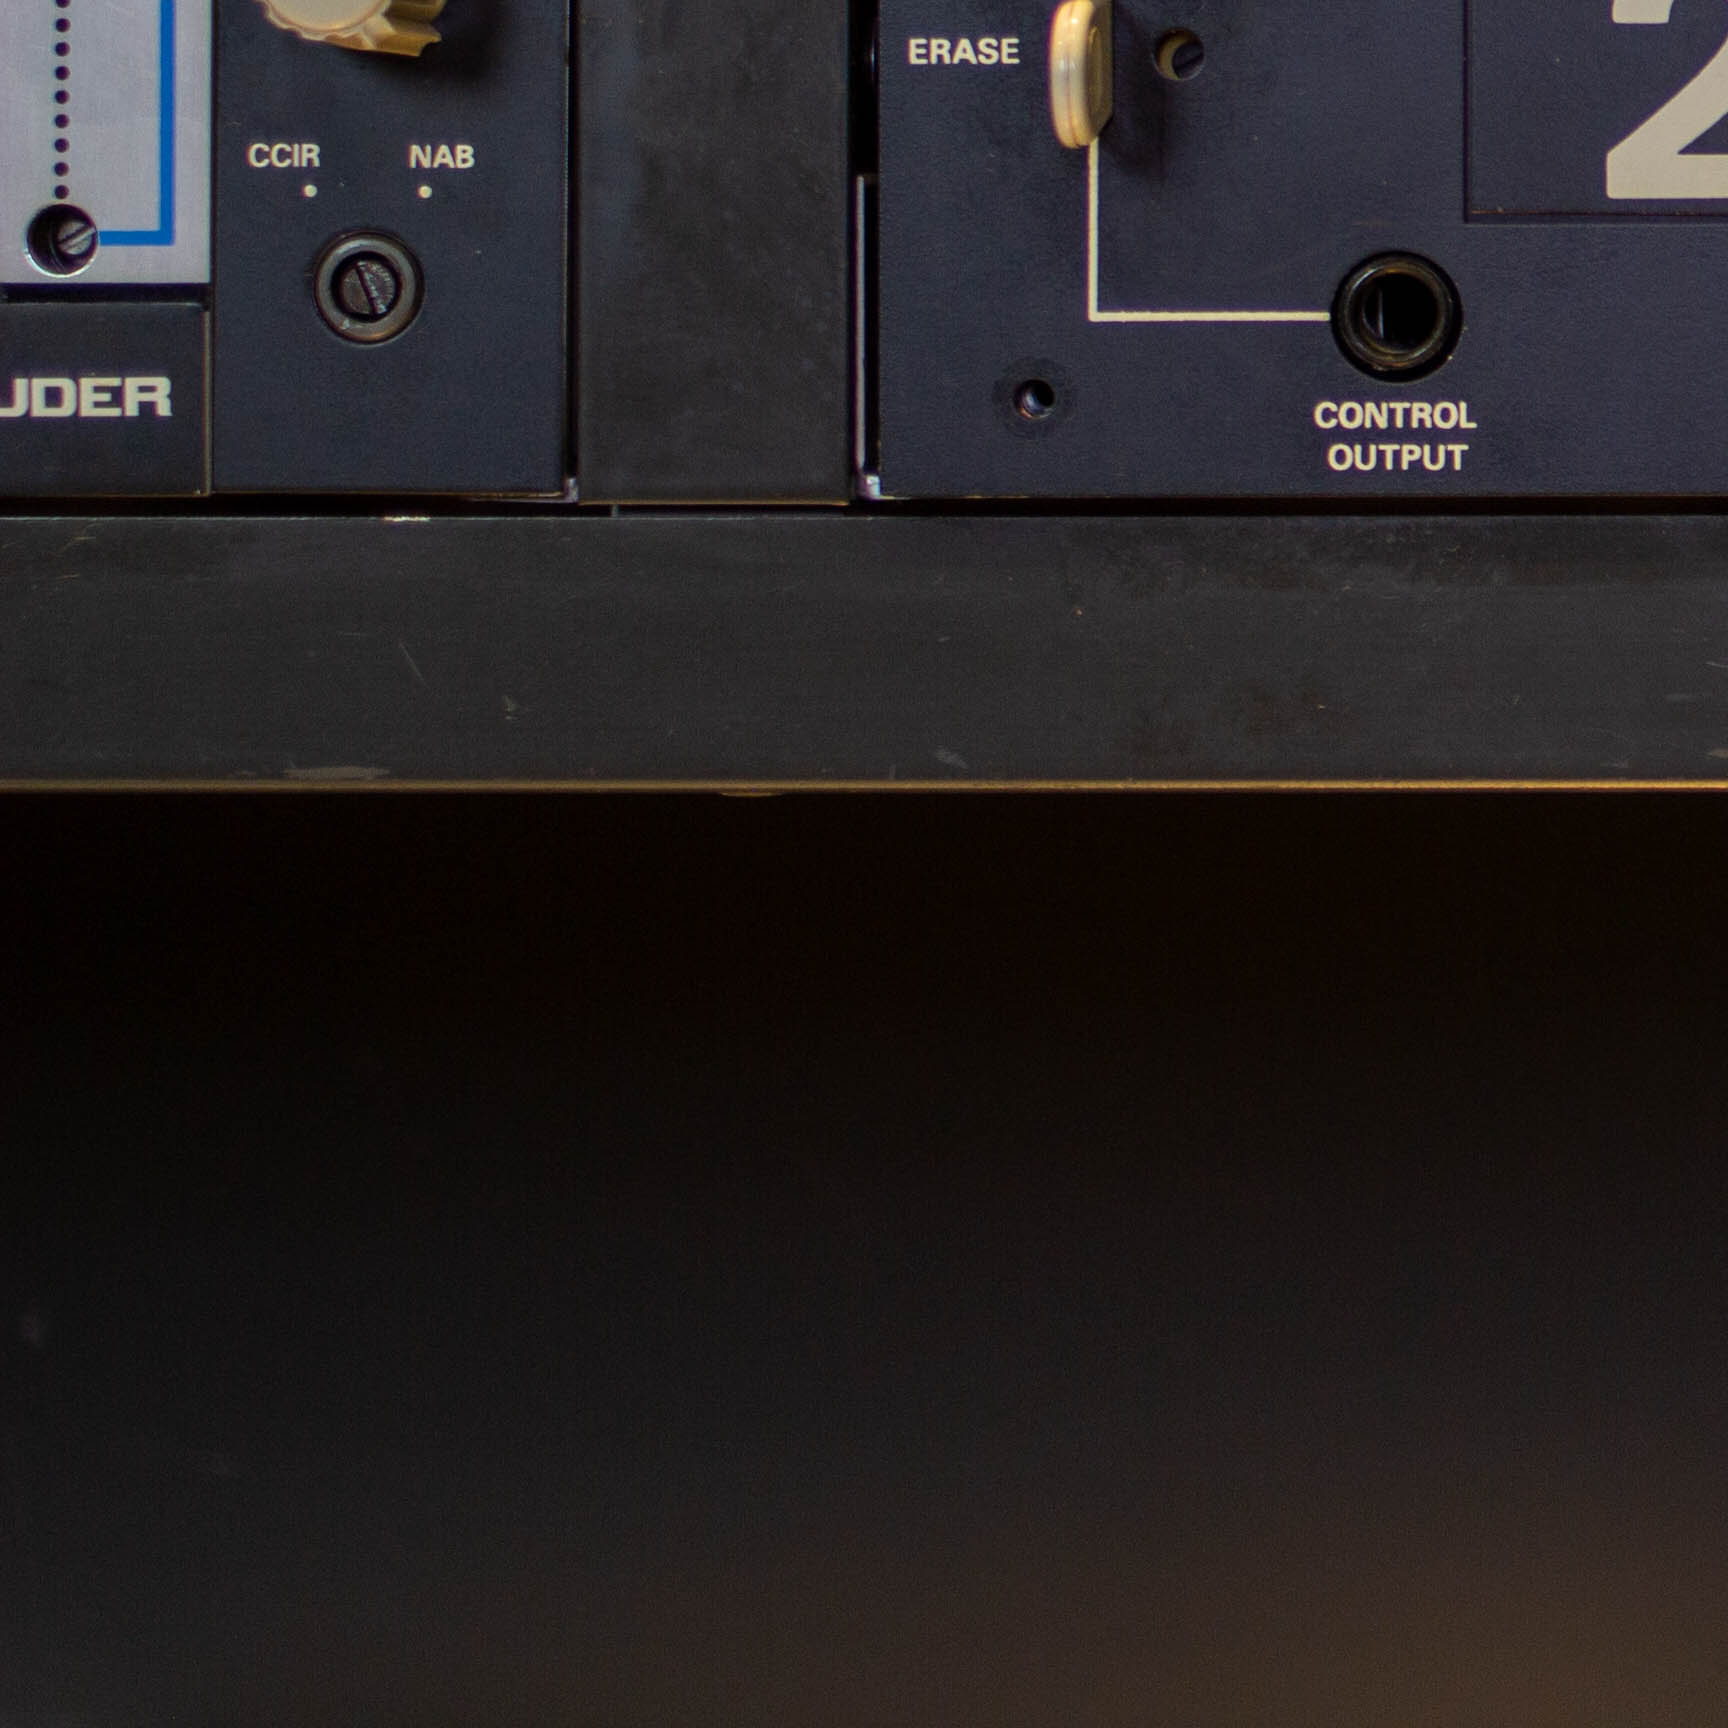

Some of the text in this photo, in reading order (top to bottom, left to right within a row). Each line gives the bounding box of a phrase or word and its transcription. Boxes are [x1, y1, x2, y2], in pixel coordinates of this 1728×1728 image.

[908, 37, 1020, 65] ERASE
[247, 142, 475, 169] CCIR NAB
[1314, 401, 1478, 430] CONTROL
[1327, 443, 1469, 471] OUTPUT
